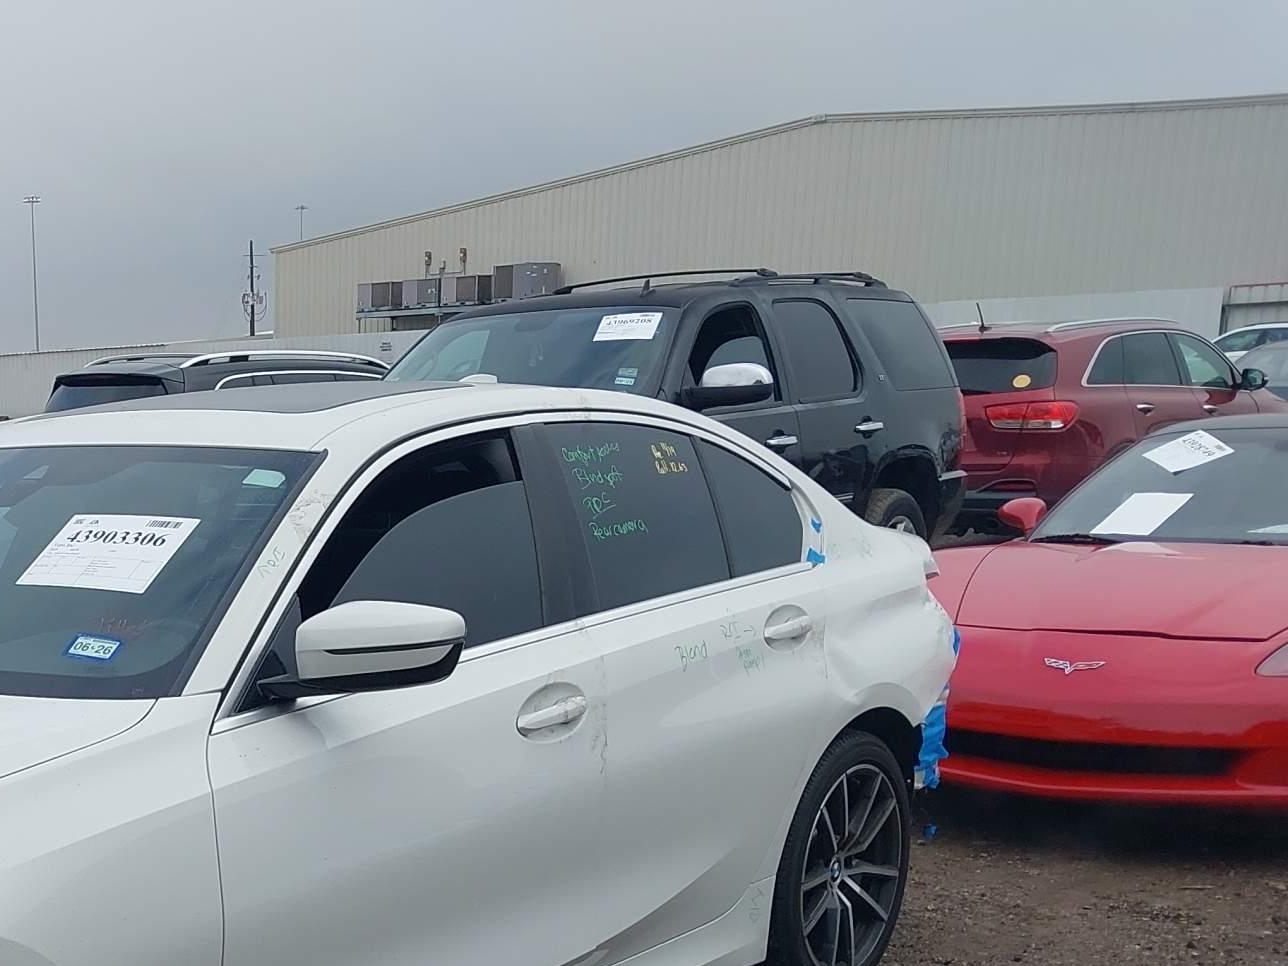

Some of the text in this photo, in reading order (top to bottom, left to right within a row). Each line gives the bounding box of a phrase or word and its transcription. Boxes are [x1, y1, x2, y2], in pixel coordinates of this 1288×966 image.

[67, 529, 174, 546] 43903306
[73, 640, 113, 656] 06 26
